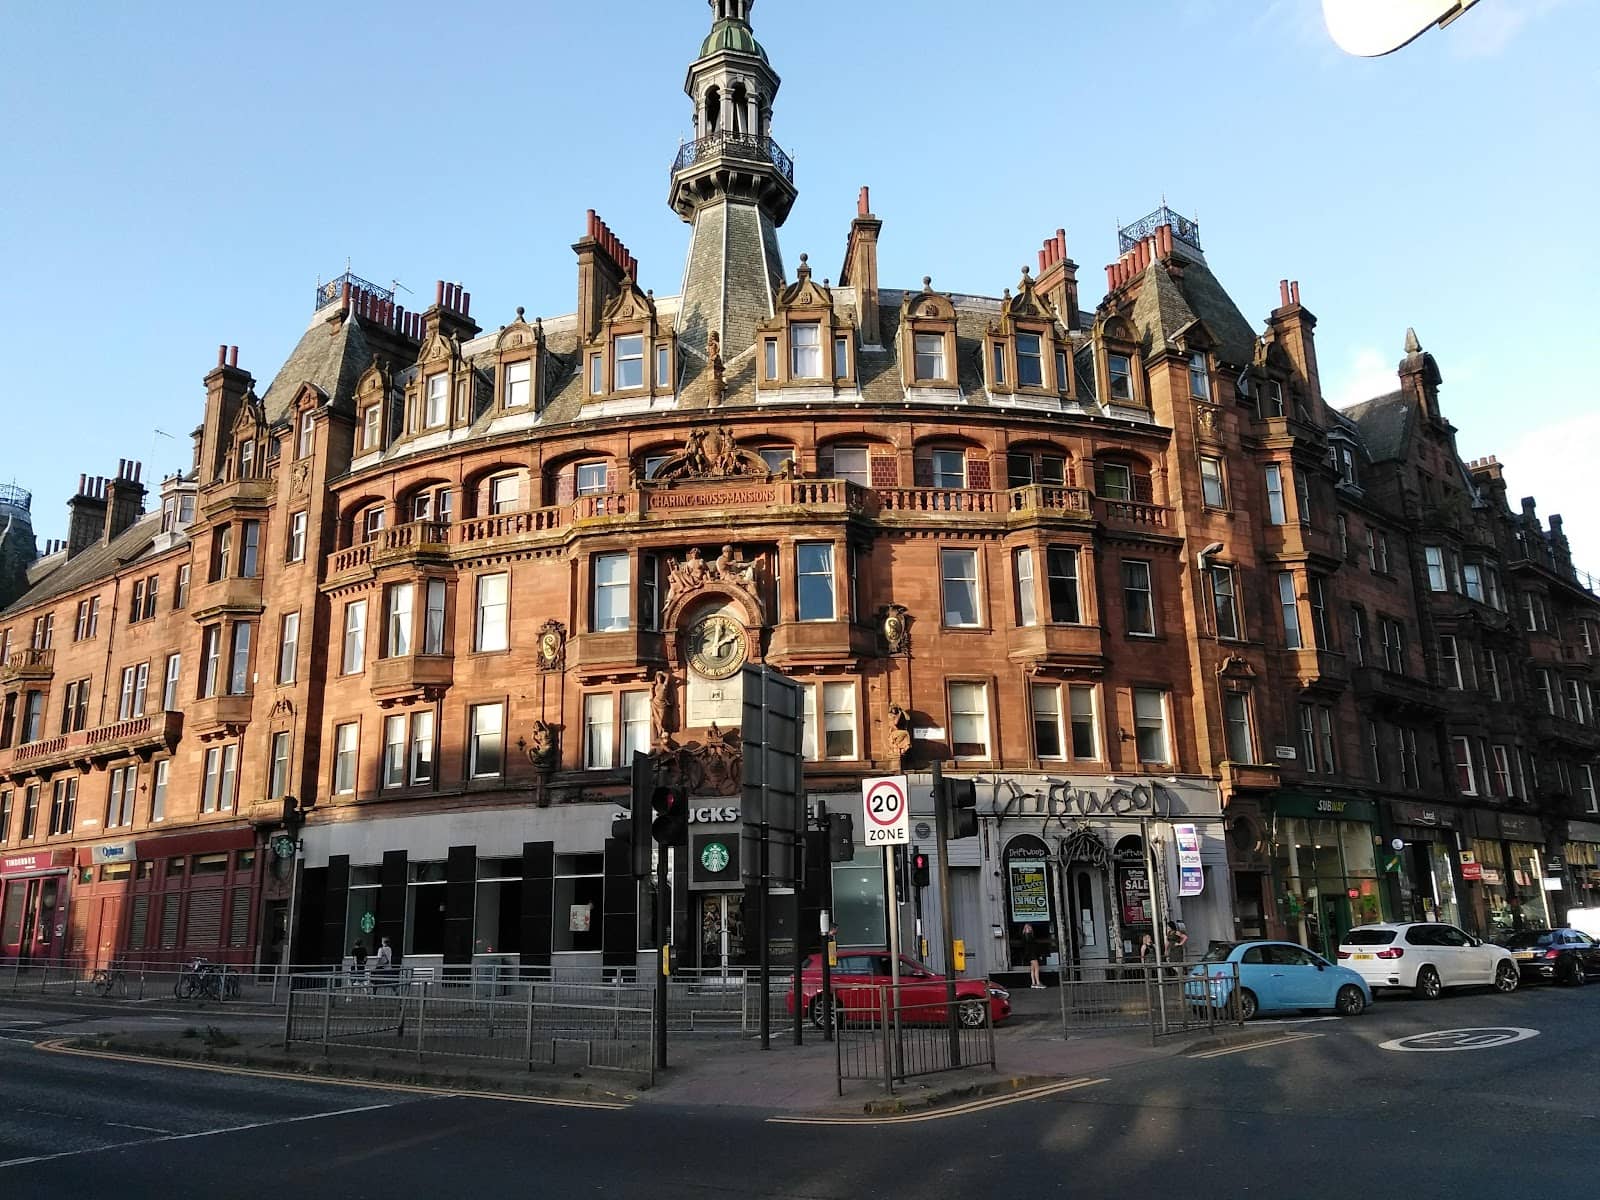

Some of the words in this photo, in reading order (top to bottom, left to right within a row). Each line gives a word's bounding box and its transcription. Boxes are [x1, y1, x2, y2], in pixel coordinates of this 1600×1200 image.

[727, 489, 776, 503] MANSIONS
[872, 794, 898, 812] 20
[1317, 800, 1346, 812] SUBWAY
[869, 828, 904, 841] ZONE
[1125, 880, 1149, 890] SALE
